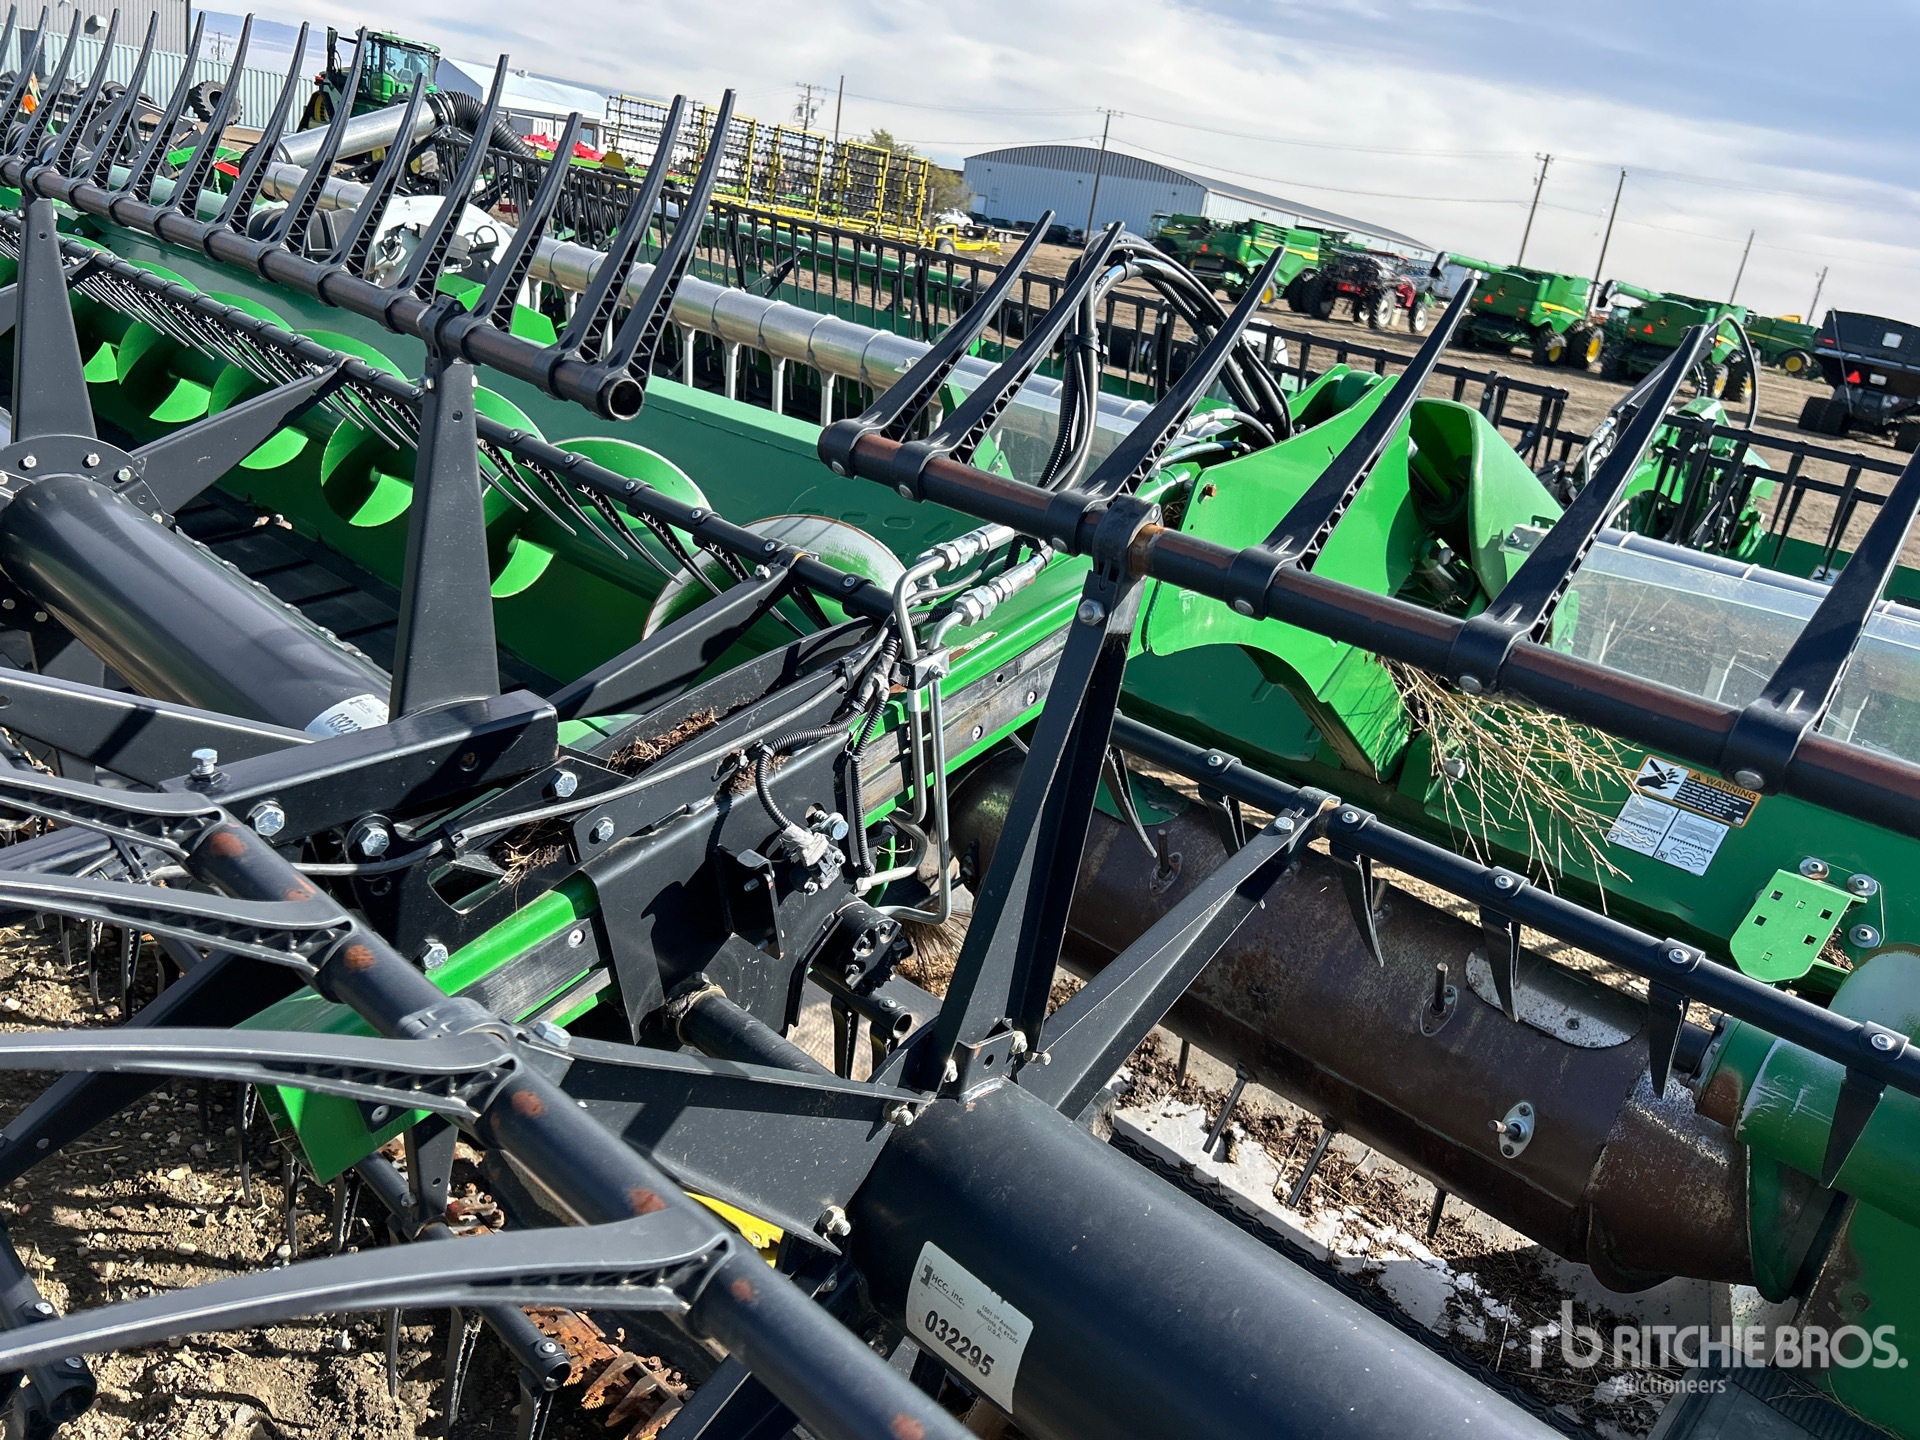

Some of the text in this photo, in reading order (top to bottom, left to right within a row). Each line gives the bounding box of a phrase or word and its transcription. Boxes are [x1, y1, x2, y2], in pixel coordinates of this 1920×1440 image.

[1706, 776, 1757, 800] WARNING
[931, 1274, 949, 1294] HCC,
[951, 1289, 965, 1306] inc.
[925, 1310, 995, 1377] 032295
